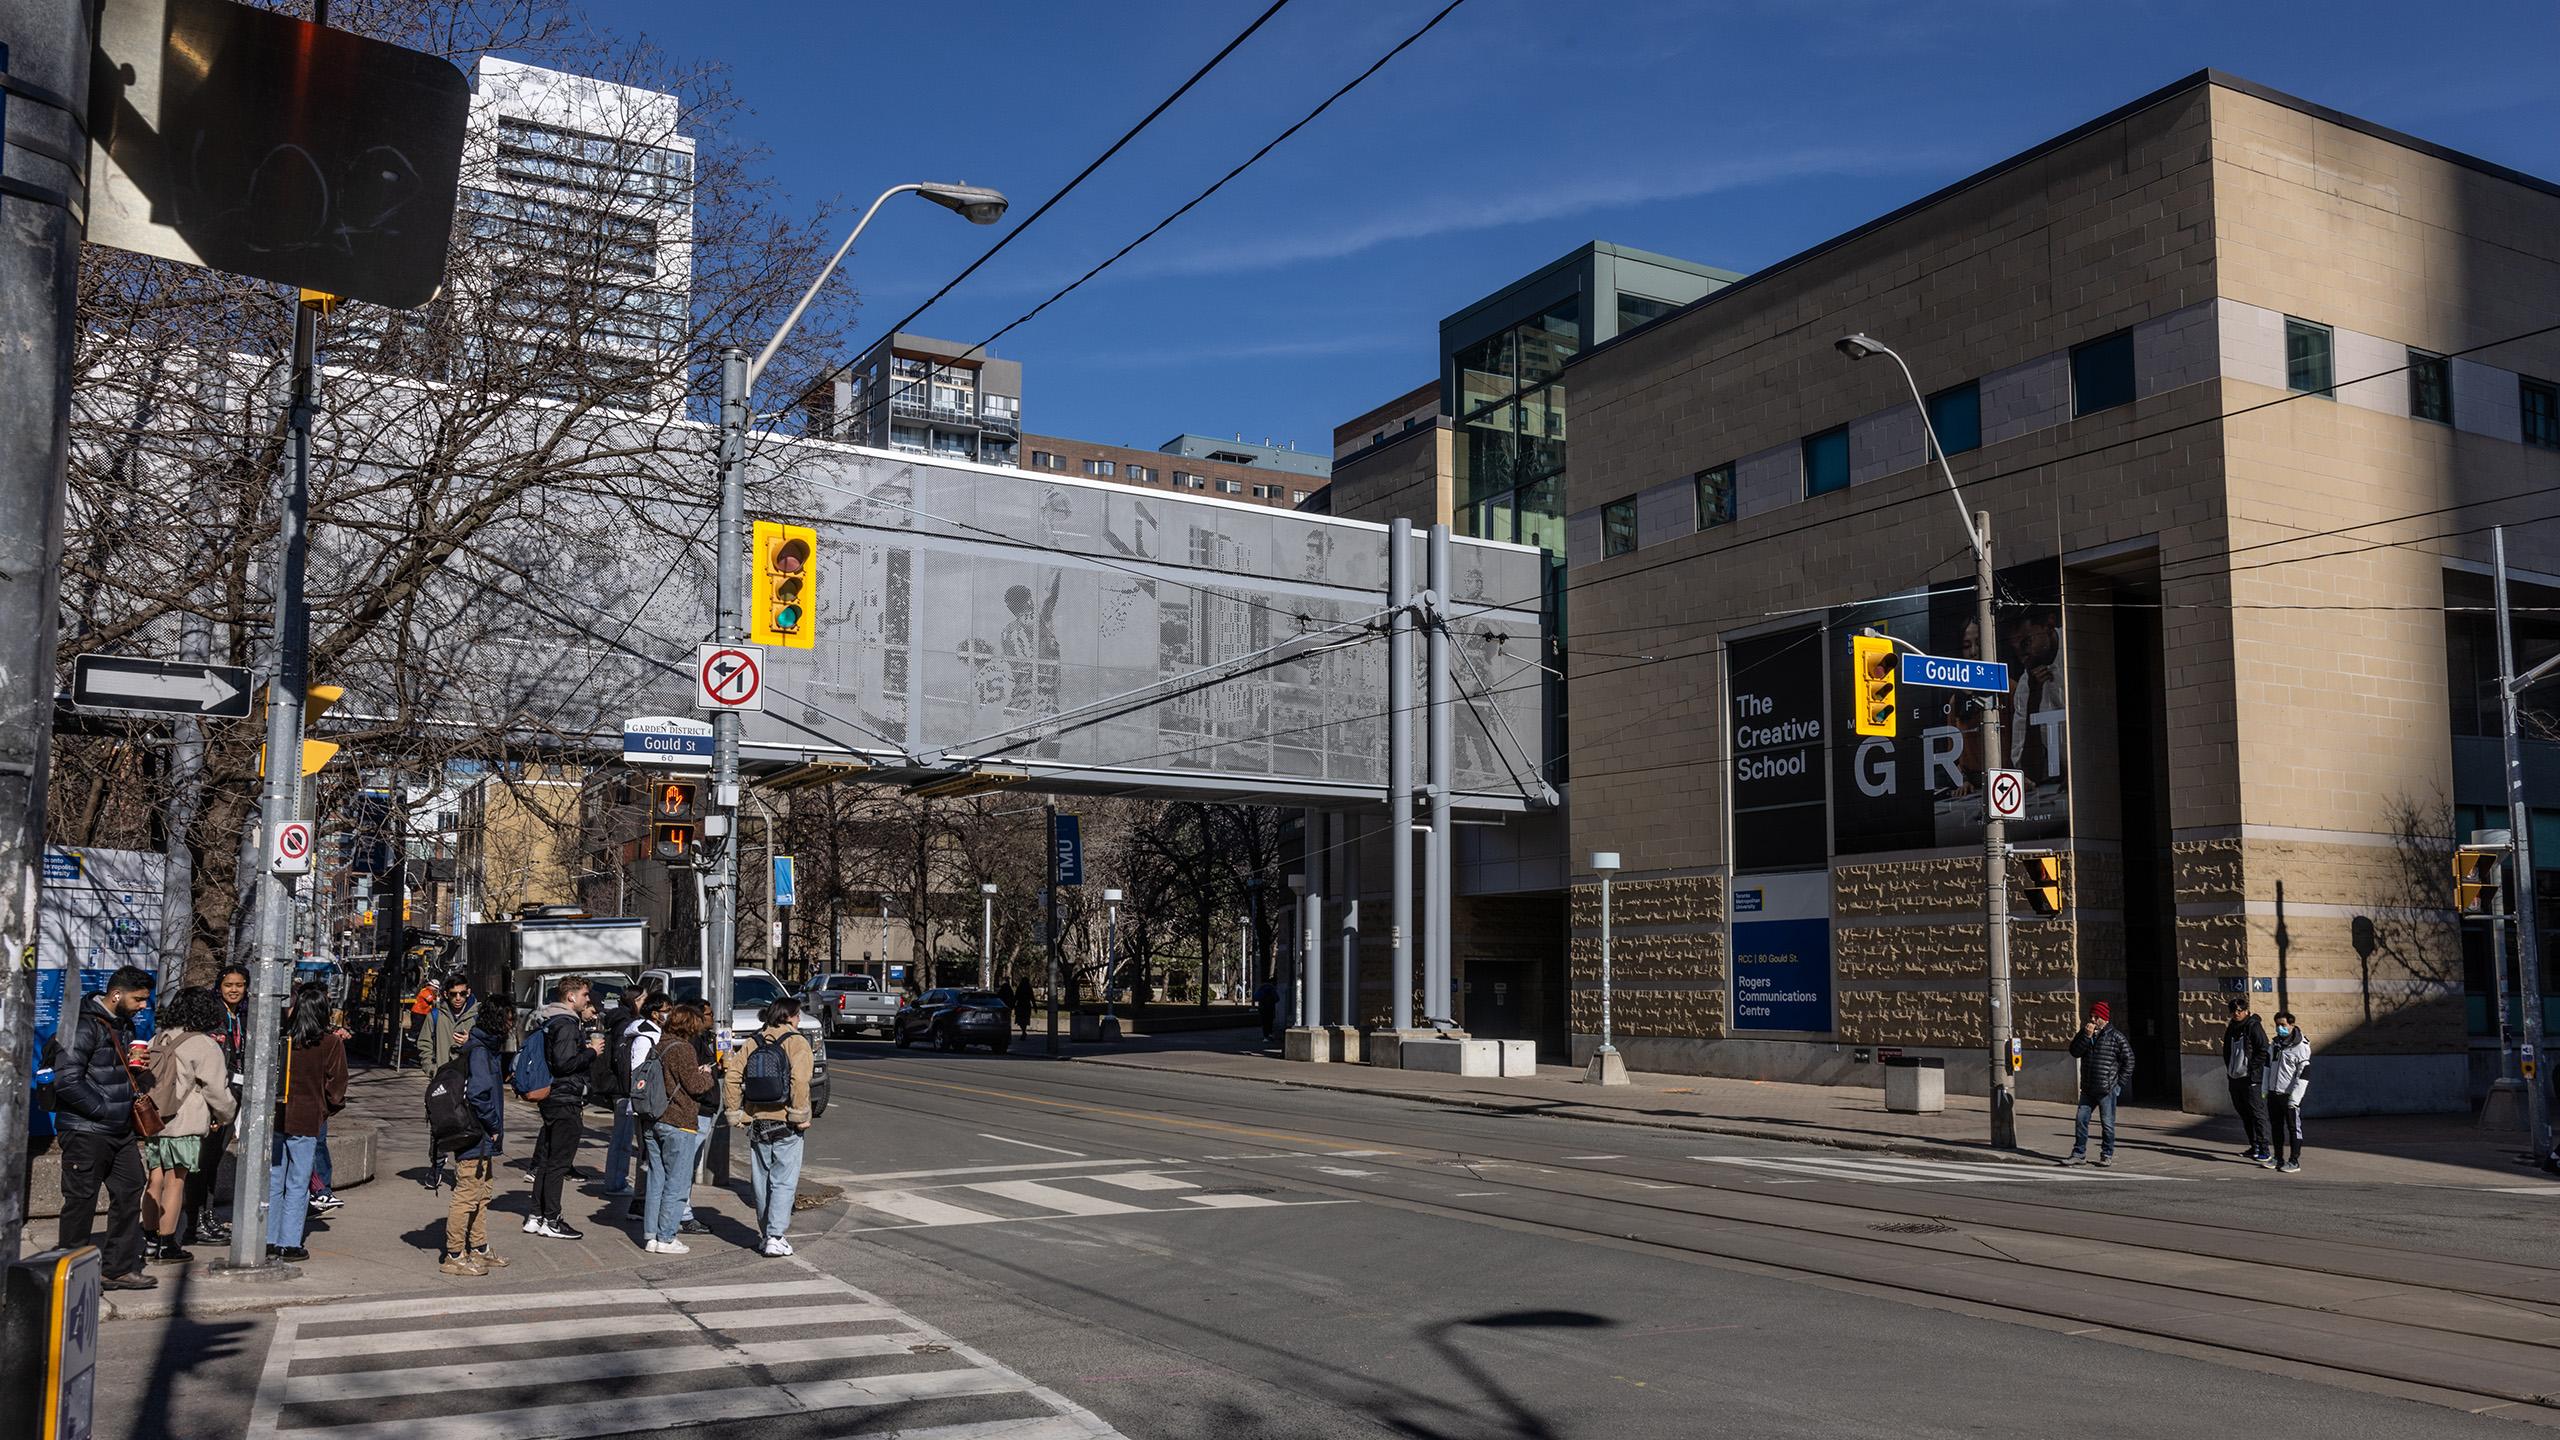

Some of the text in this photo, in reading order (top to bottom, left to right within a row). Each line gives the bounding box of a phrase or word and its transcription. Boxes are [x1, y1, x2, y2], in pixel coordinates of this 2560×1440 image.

[1925, 660, 1985, 683] Gould St
[1736, 694, 1773, 718] The
[632, 725, 706, 736] GARDEN DISTRICT
[1737, 718, 1820, 749] Creative
[644, 737, 696, 752] Gould St
[1854, 709, 2066, 798] GRT
[661, 754, 674, 762] 60
[1738, 749, 1806, 782] School
[671, 829, 684, 854] 4
[1059, 839, 1073, 881] TMU
[1738, 954, 1753, 964] RCC
[1758, 954, 1767, 964] 80
[1768, 953, 1788, 963] Gould
[1789, 953, 1799, 963] St.
[1738, 976, 1771, 990] Rogers
[1739, 990, 1817, 1003] Communications
[1739, 1004, 1771, 1017] Centre
